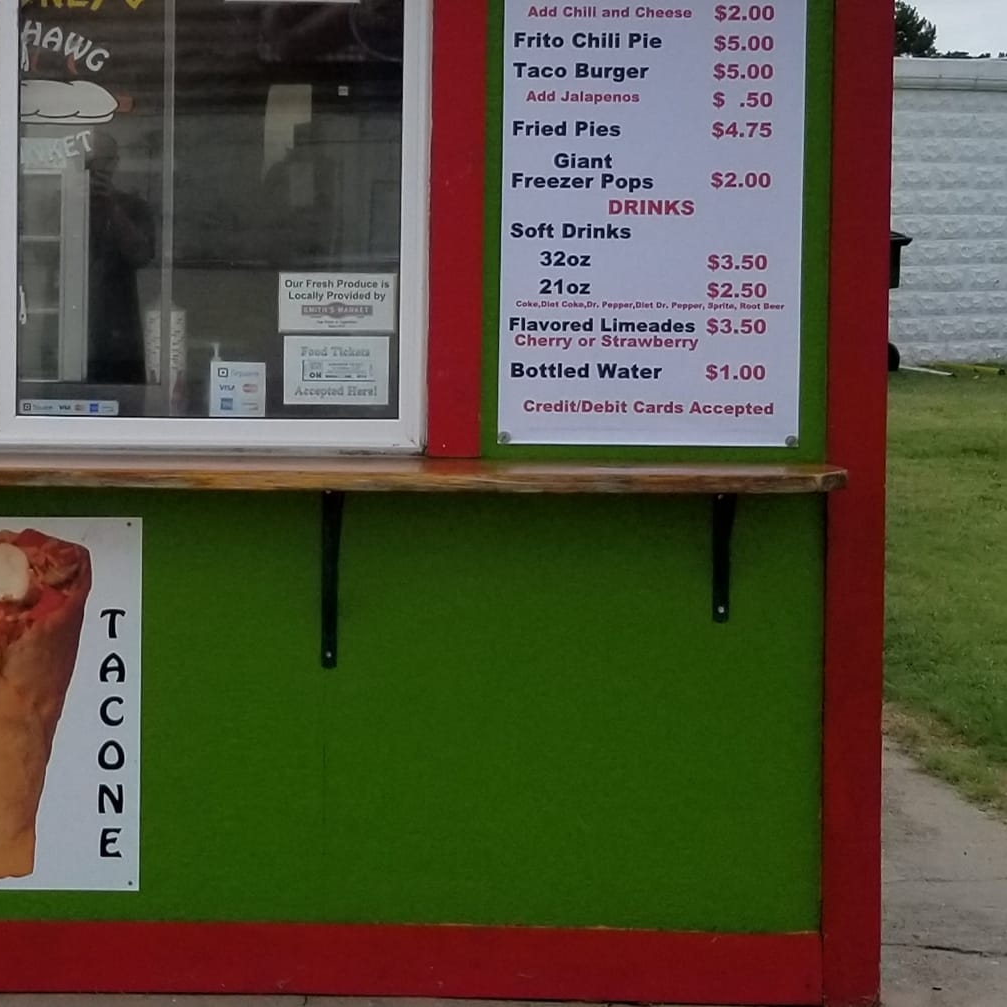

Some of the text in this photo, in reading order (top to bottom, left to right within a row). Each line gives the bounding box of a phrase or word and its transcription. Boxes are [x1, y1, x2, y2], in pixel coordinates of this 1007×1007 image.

[528, 5, 775, 22] Add Chili and Cheese $2.00
[21, 20, 111, 72] HAWG
[514, 33, 774, 52] Frito Chili Pie $5.00
[513, 63, 774, 82] Taco Burger $5.00
[526, 91, 555, 102] Add
[561, 92, 640, 105] Jalapenos
[512, 121, 772, 139] Fried Pies $4.75
[554, 153, 613, 169] Giant
[511, 172, 771, 192] Freezer Pops $2.00
[608, 200, 695, 216] DRINKS
[510, 223, 631, 239] Soft Drinks
[540, 251, 768, 271] 32oz $3.50
[285, 280, 389, 288] Our Fresh Produce is
[539, 279, 767, 299] 21oz $2.50
[289, 292, 385, 301] Locally Provided by
[509, 317, 766, 335] Flavored Limeades $3.50
[514, 335, 698, 350] Cherry or Strawberry
[510, 362, 766, 381] Bottled Water $1.00
[524, 400, 774, 417] Credit/Debit Cards Accepted
